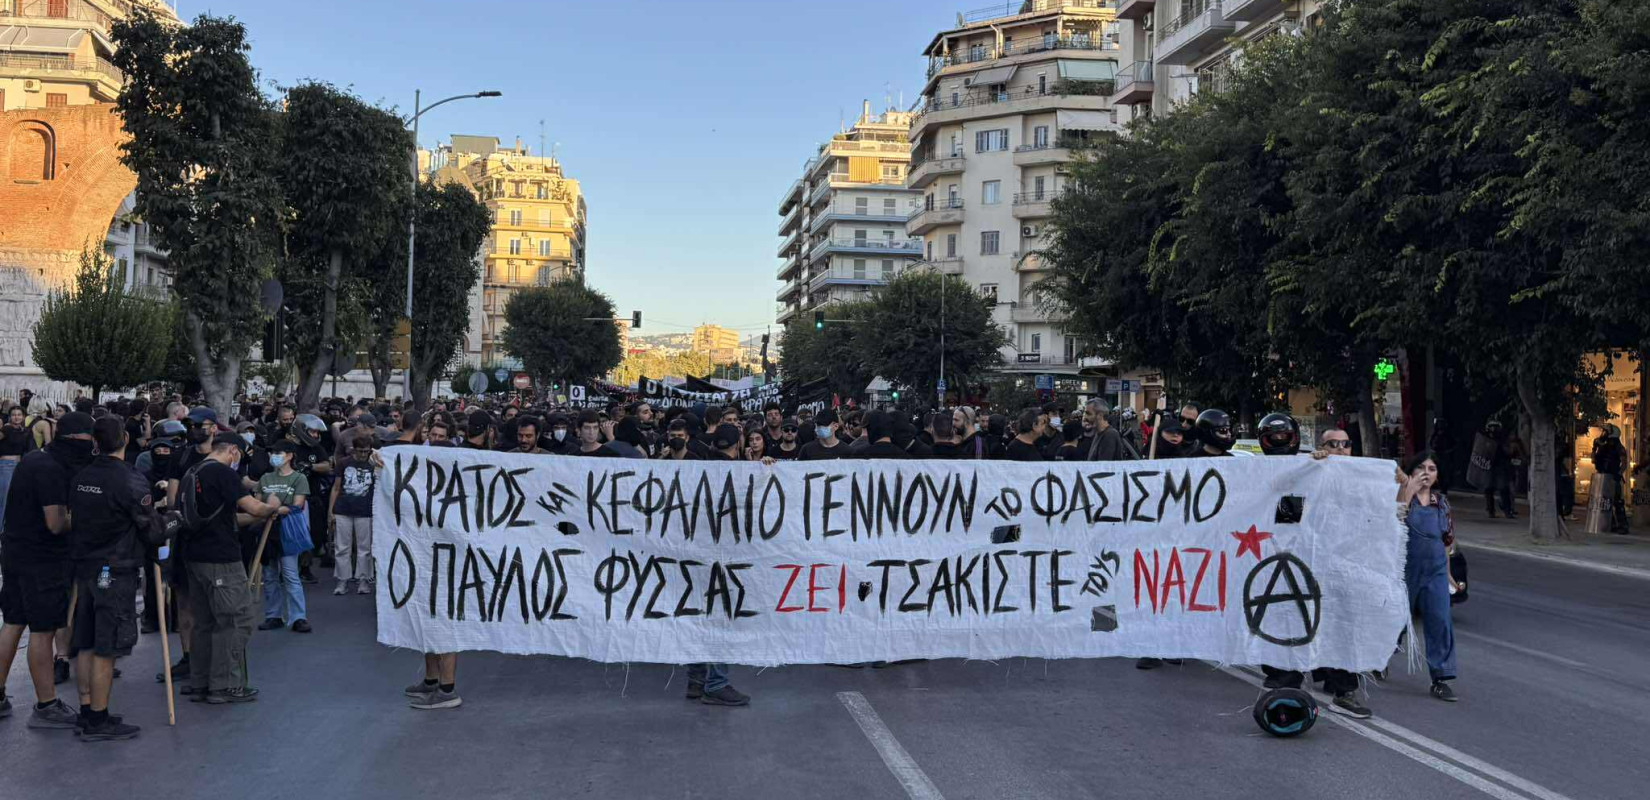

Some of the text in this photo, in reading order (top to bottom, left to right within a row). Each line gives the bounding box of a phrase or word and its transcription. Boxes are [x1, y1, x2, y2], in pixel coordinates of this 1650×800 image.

[394, 453, 1226, 544] ΚΡΑΤΟΣ ΚΑΙ ΚΕΦΑΛΑΙΟ ΓΕΝΝΟΥΝ ΤΟ ΦΑΣΙΣΜΟ
[387, 537, 1226, 624] Ο ΠΑΥΛΟΣ ΦΥΣΣΑΣ ΖΕΙ ΤΣΑΚΙΣΤΕ ΤΟΥΣ ΝΑΖΙ
